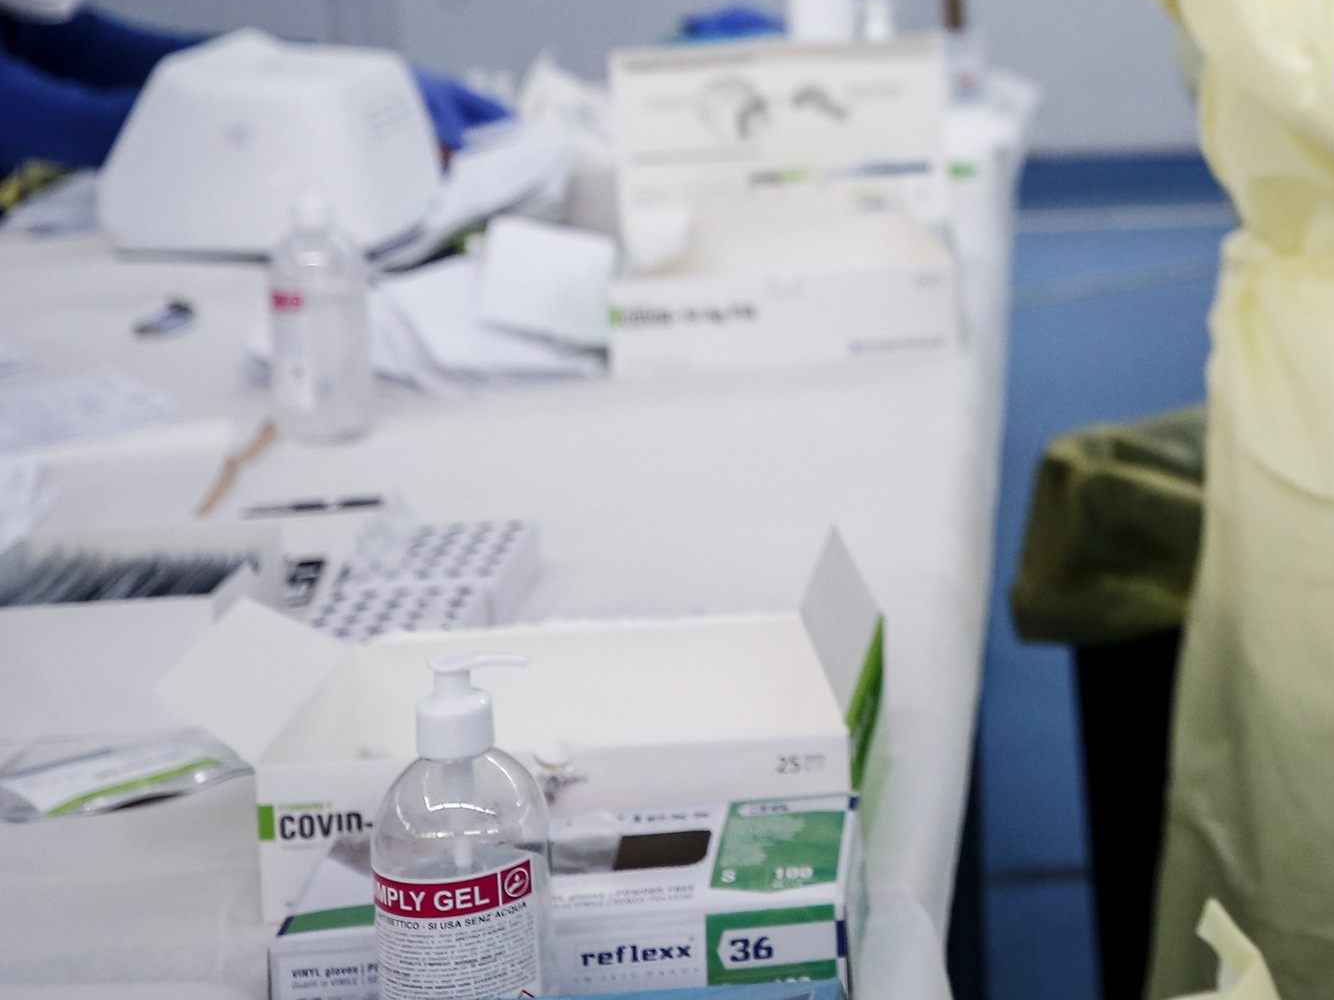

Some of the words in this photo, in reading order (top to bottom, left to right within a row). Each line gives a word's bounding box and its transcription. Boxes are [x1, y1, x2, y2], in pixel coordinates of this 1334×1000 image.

[433, 886, 490, 912] GEL
[440, 919, 462, 930] USA
[580, 944, 692, 967] reflexx
[729, 936, 774, 963] 36
[291, 967, 319, 978] VINYL
